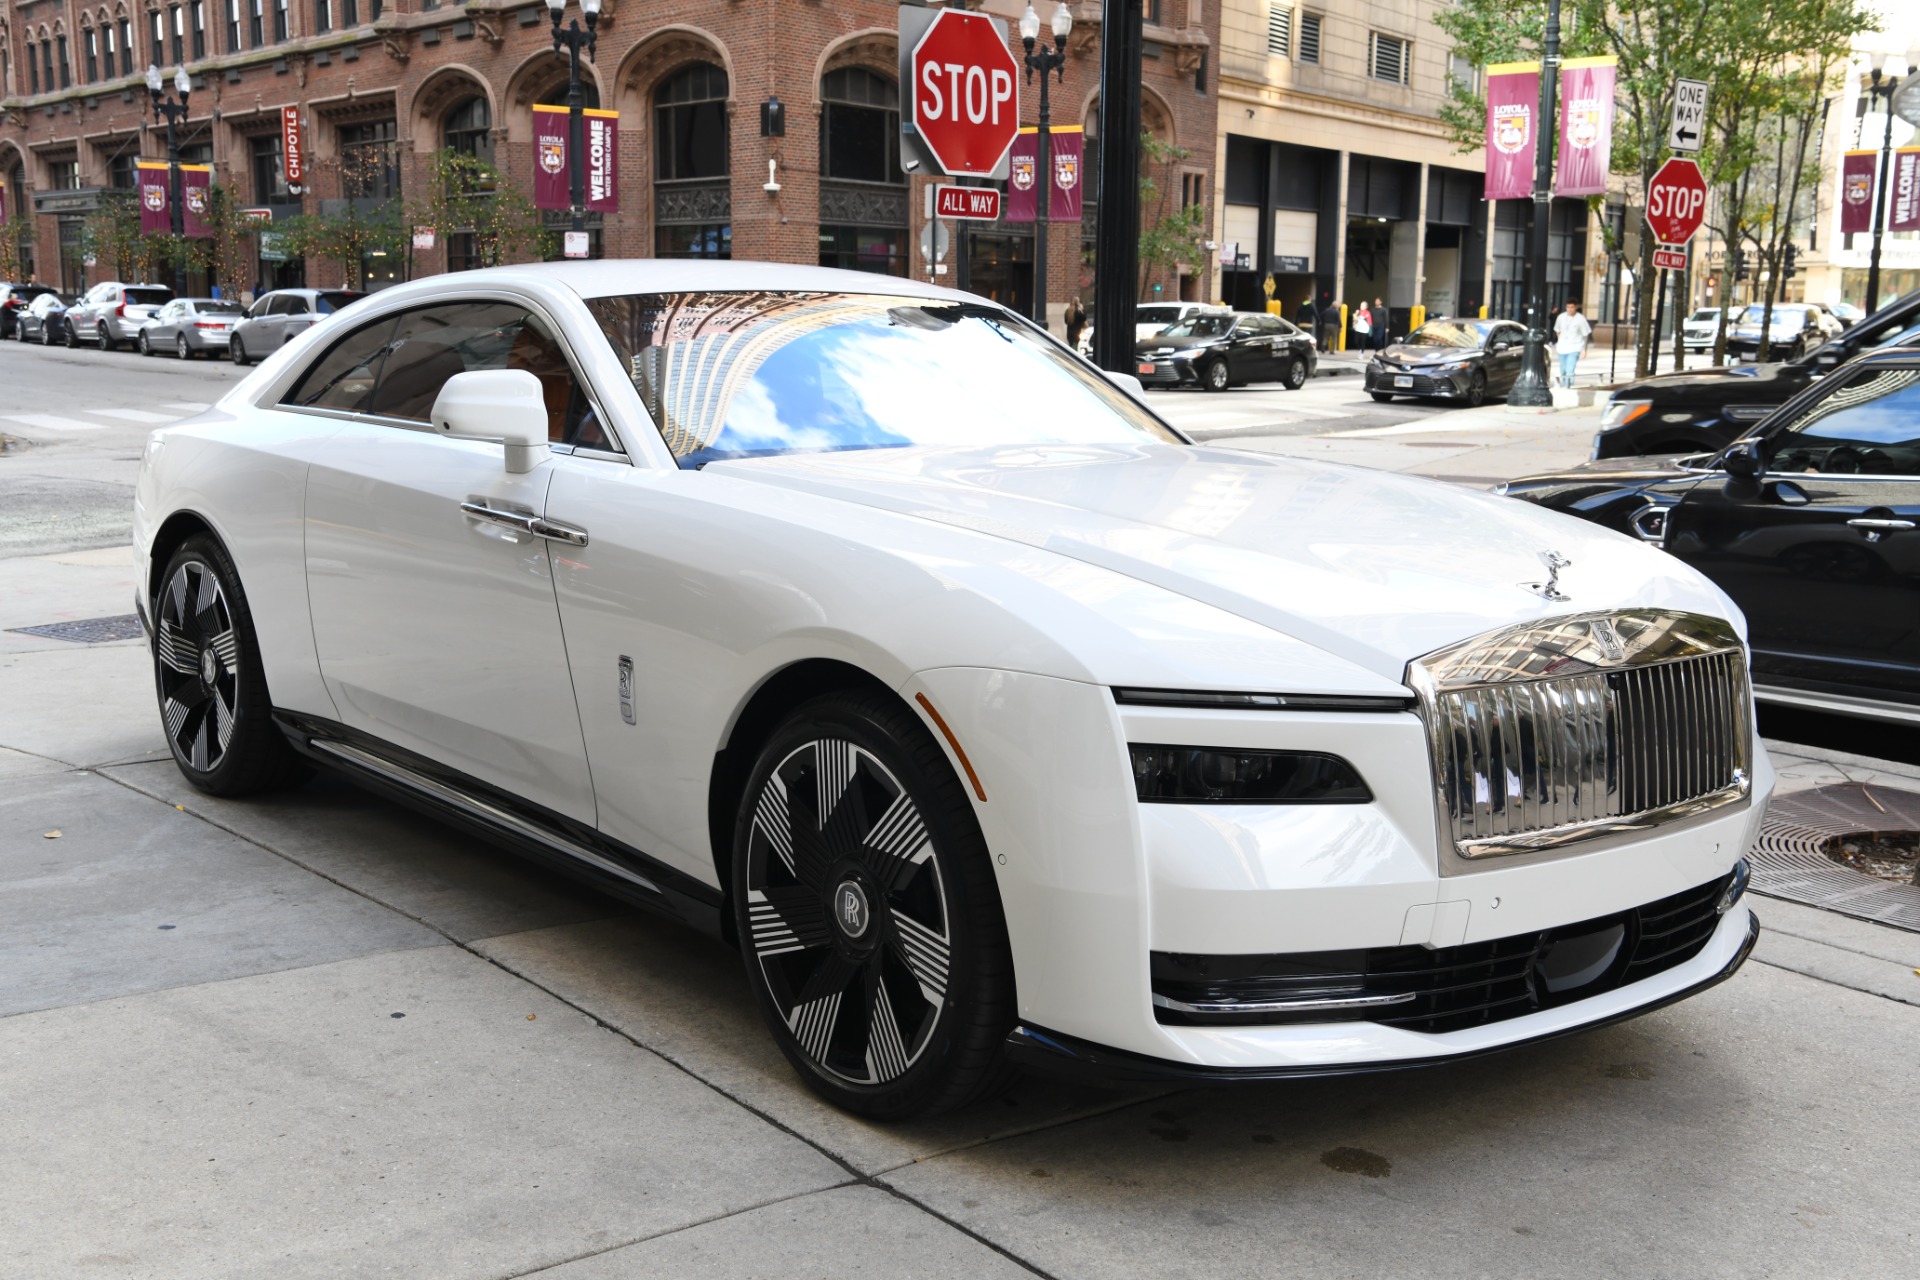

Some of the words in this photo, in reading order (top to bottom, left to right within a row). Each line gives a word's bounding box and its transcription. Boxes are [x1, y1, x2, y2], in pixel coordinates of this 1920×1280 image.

[921, 60, 1012, 125] STOP
[1679, 86, 1704, 105] ONE
[1494, 104, 1530, 114] LOYOLA
[1676, 104, 1702, 124] WAY
[287, 110, 300, 179] CHIPOTLE
[539, 135, 565, 144] LOYOLA
[591, 120, 604, 201] WELCOME
[1012, 155, 1035, 163] LOYOLA
[1055, 154, 1078, 162] LOYOLA
[1894, 154, 1916, 225] WELCOME
[943, 194, 965, 211] ALL
[970, 194, 994, 213] WAY
[1651, 185, 1704, 220] STOP
[1656, 253, 1670, 265] ALL
[1671, 254, 1685, 267] WAY
